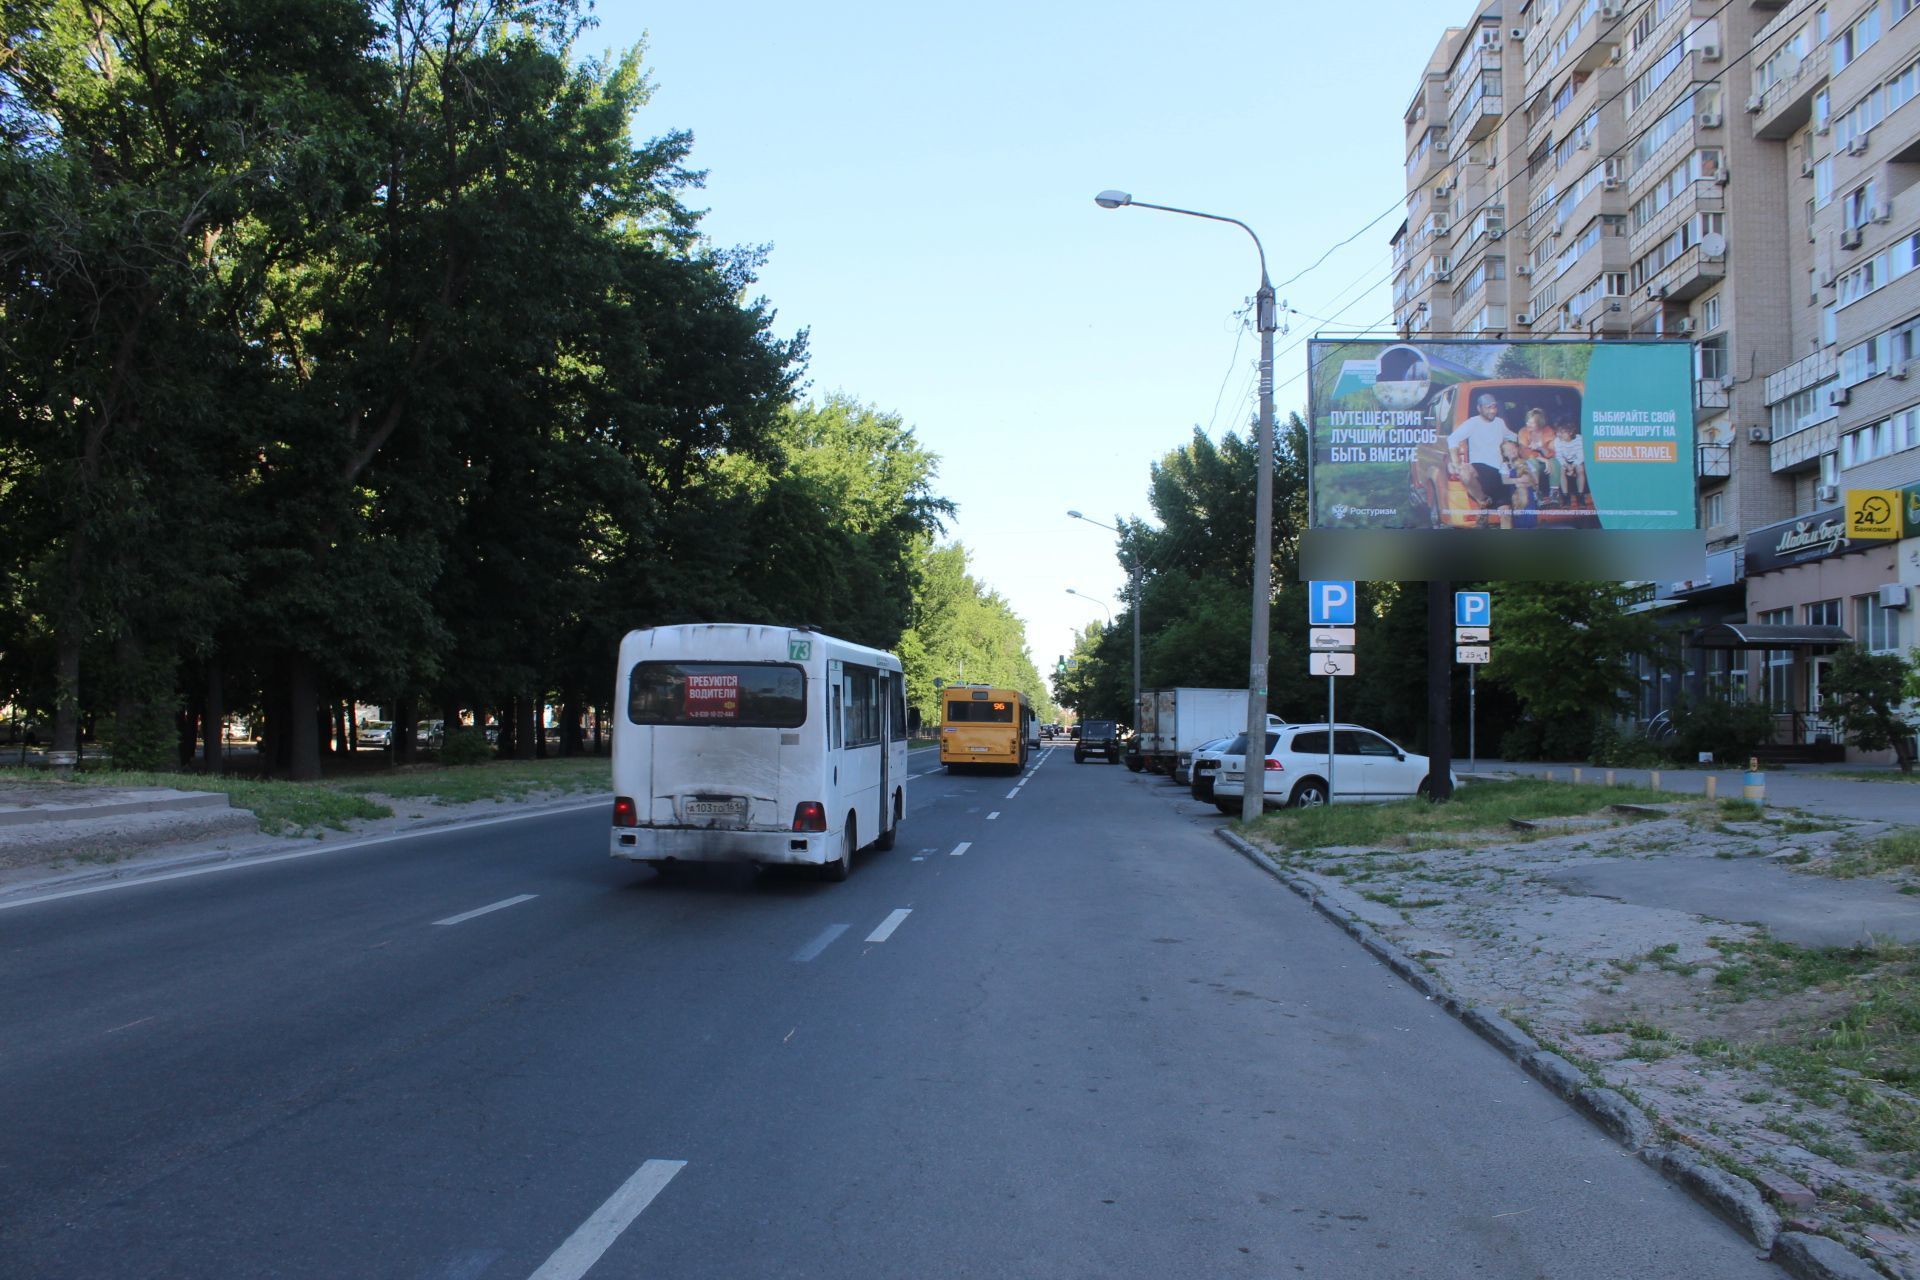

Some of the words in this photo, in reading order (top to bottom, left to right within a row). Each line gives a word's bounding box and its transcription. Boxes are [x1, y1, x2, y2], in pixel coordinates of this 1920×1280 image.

[1331, 411, 1421, 425] ПУТЕШЕСТВИЯ
[1593, 410, 1649, 422] ВЫБИРАЙТЕ
[1651, 410, 1676, 422] СВОЙ
[1331, 426, 1385, 443] ЛУЧШИЙ
[1389, 429, 1437, 443] СПОСОБ
[1593, 425, 1661, 436] АВТОМАРШРУТ
[1663, 425, 1676, 436] НА
[1331, 447, 1366, 461] БЫТЬ
[1369, 447, 1418, 462] ВМЕСТЕ
[1598, 446, 1671, 459] RUSSIA.TRAVEL
[1350, 506, 1397, 516] Ростуризм
[1854, 511, 1874, 524] 24
[791, 641, 809, 660] 73
[688, 676, 738, 686] ТРЕБУЮТСЯ
[690, 689, 736, 699] ВОДИТЕЛИ
[993, 702, 1005, 710] 96
